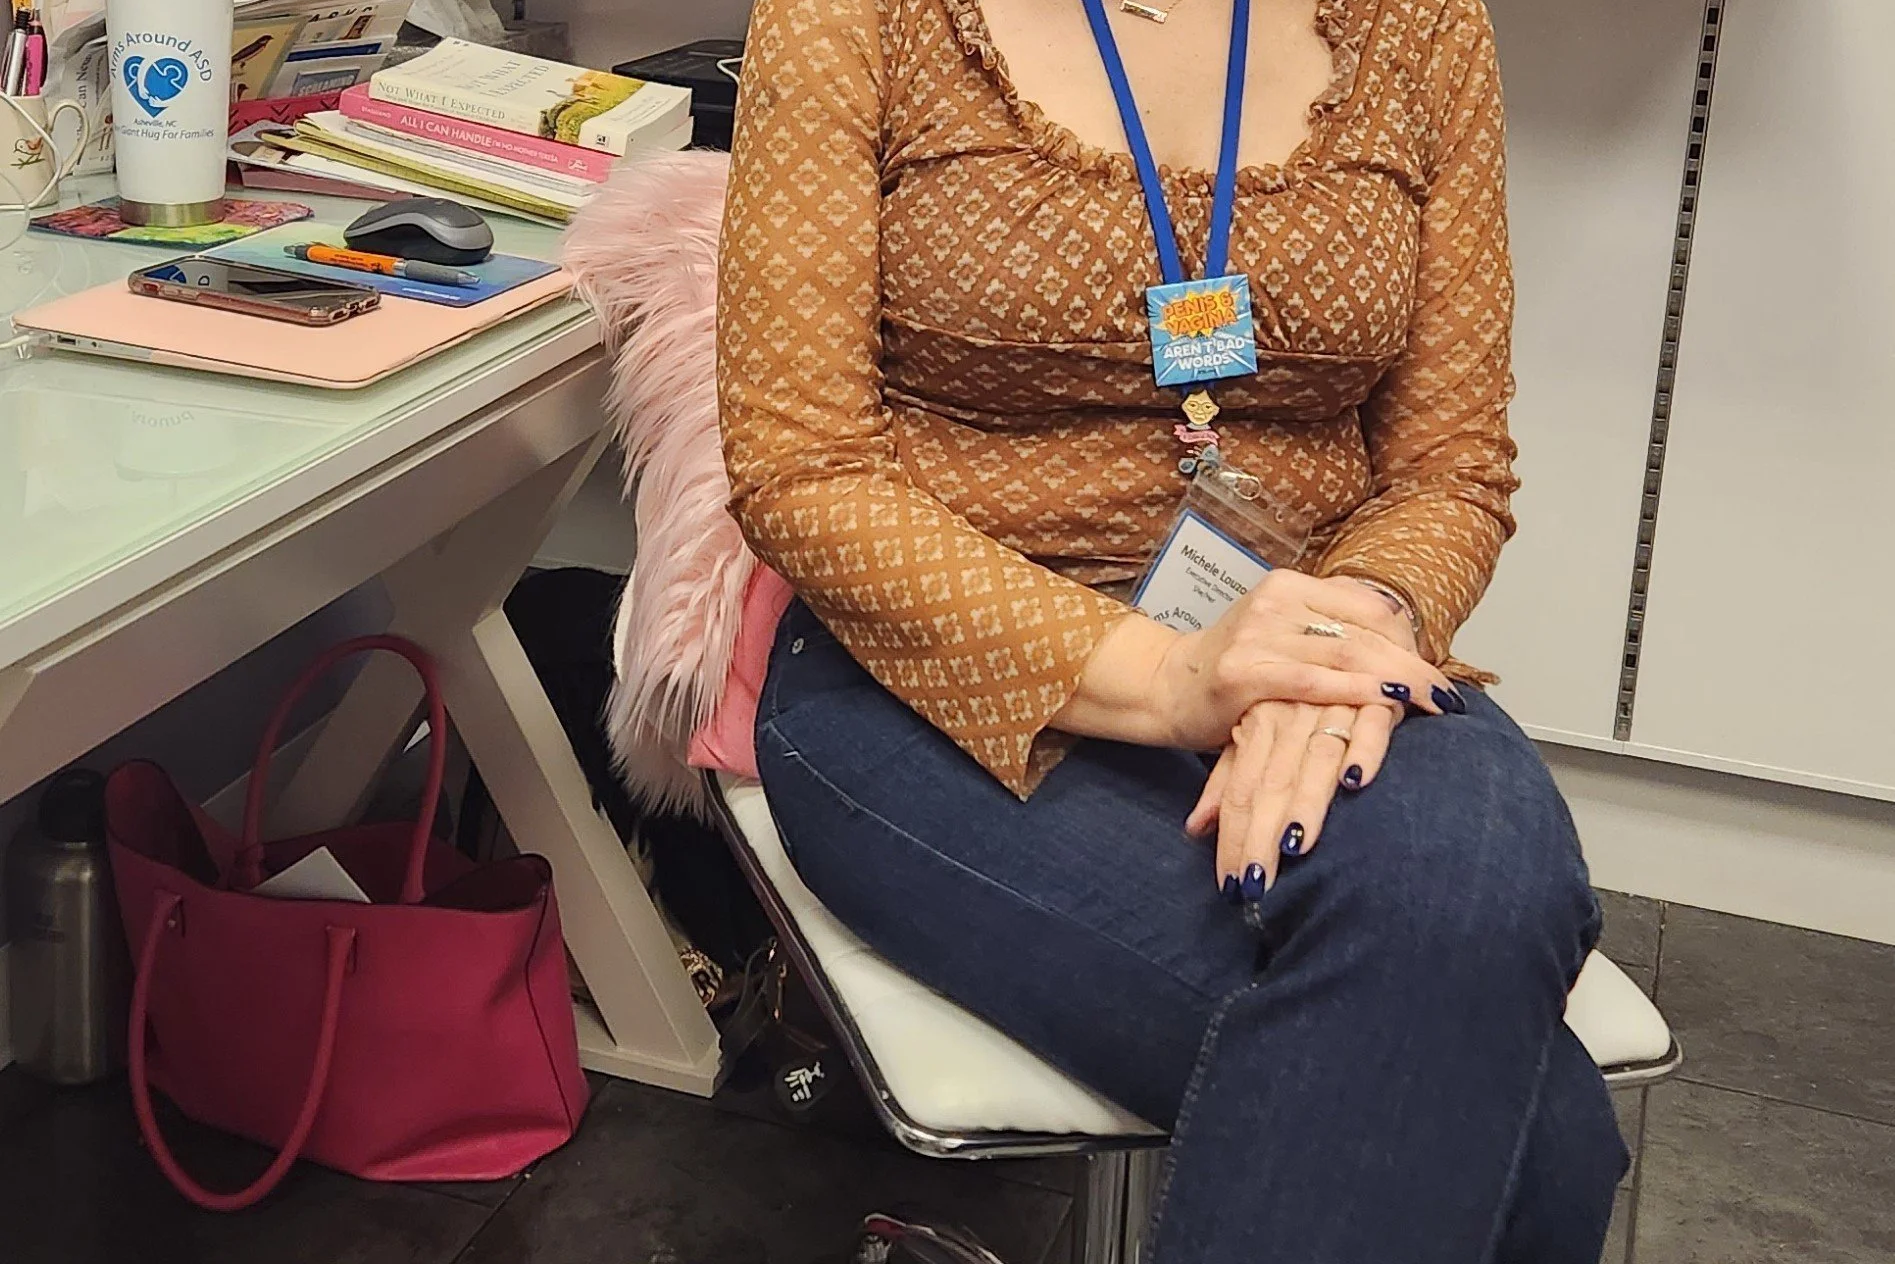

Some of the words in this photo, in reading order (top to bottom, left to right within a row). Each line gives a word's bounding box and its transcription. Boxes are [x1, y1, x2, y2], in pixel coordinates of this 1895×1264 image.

[126, 32, 192, 53] Around
[189, 49, 213, 82] ASD
[378, 82, 400, 95] NOT
[405, 87, 437, 104] WHAT
[450, 98, 506, 120] EXPECTED
[141, 127, 160, 141] Hug
[163, 129, 178, 139] For
[400, 115, 418, 129] ALL
[426, 121, 449, 137] CAN
[451, 127, 493, 148] HANDLE
[1163, 294, 1218, 320] PENIS
[1166, 308, 1237, 336] VAGINA
[1216, 338, 1245, 352] BAD
[1177, 352, 1231, 370] WORDS
[1180, 544, 1219, 577] Michele
[1219, 571, 1248, 596] Louzo
[1172, 607, 1203, 632] Aroun
